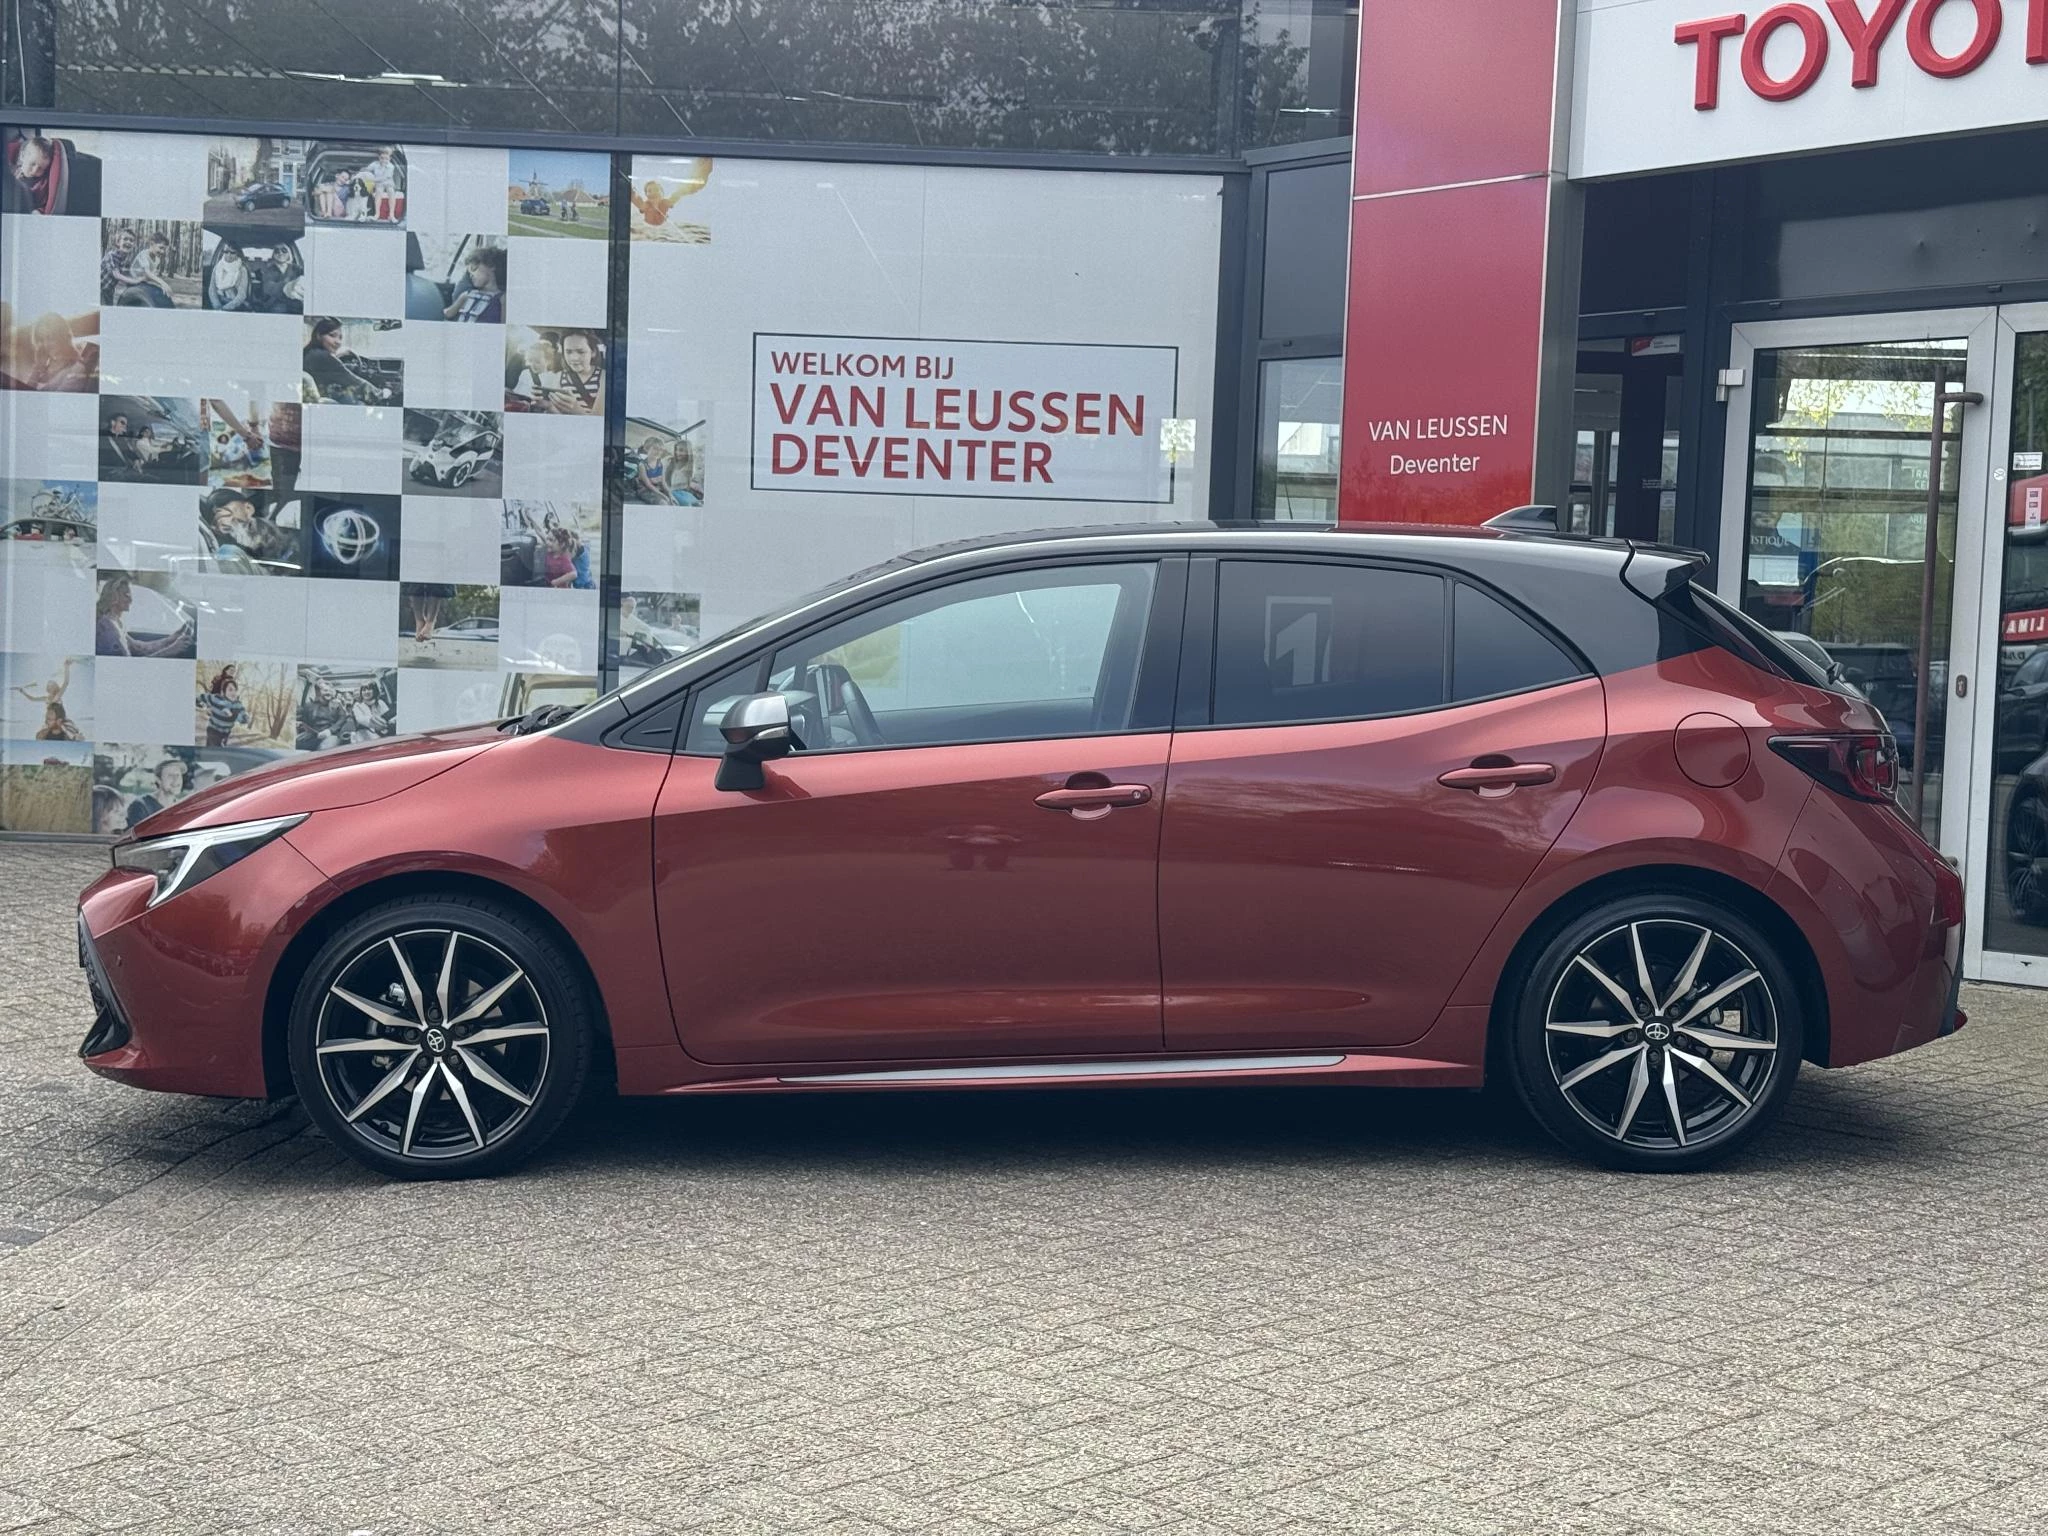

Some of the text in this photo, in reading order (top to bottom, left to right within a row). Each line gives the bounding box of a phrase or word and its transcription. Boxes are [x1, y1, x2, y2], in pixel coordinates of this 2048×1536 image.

[771, 351, 954, 380] WELKOM BIJ
[770, 383, 1144, 437] VAN LEUSSEN
[1368, 414, 1508, 441] VAN LEUSSEN
[771, 433, 1054, 484] DEVENTER
[1390, 453, 1480, 475] Deventer
